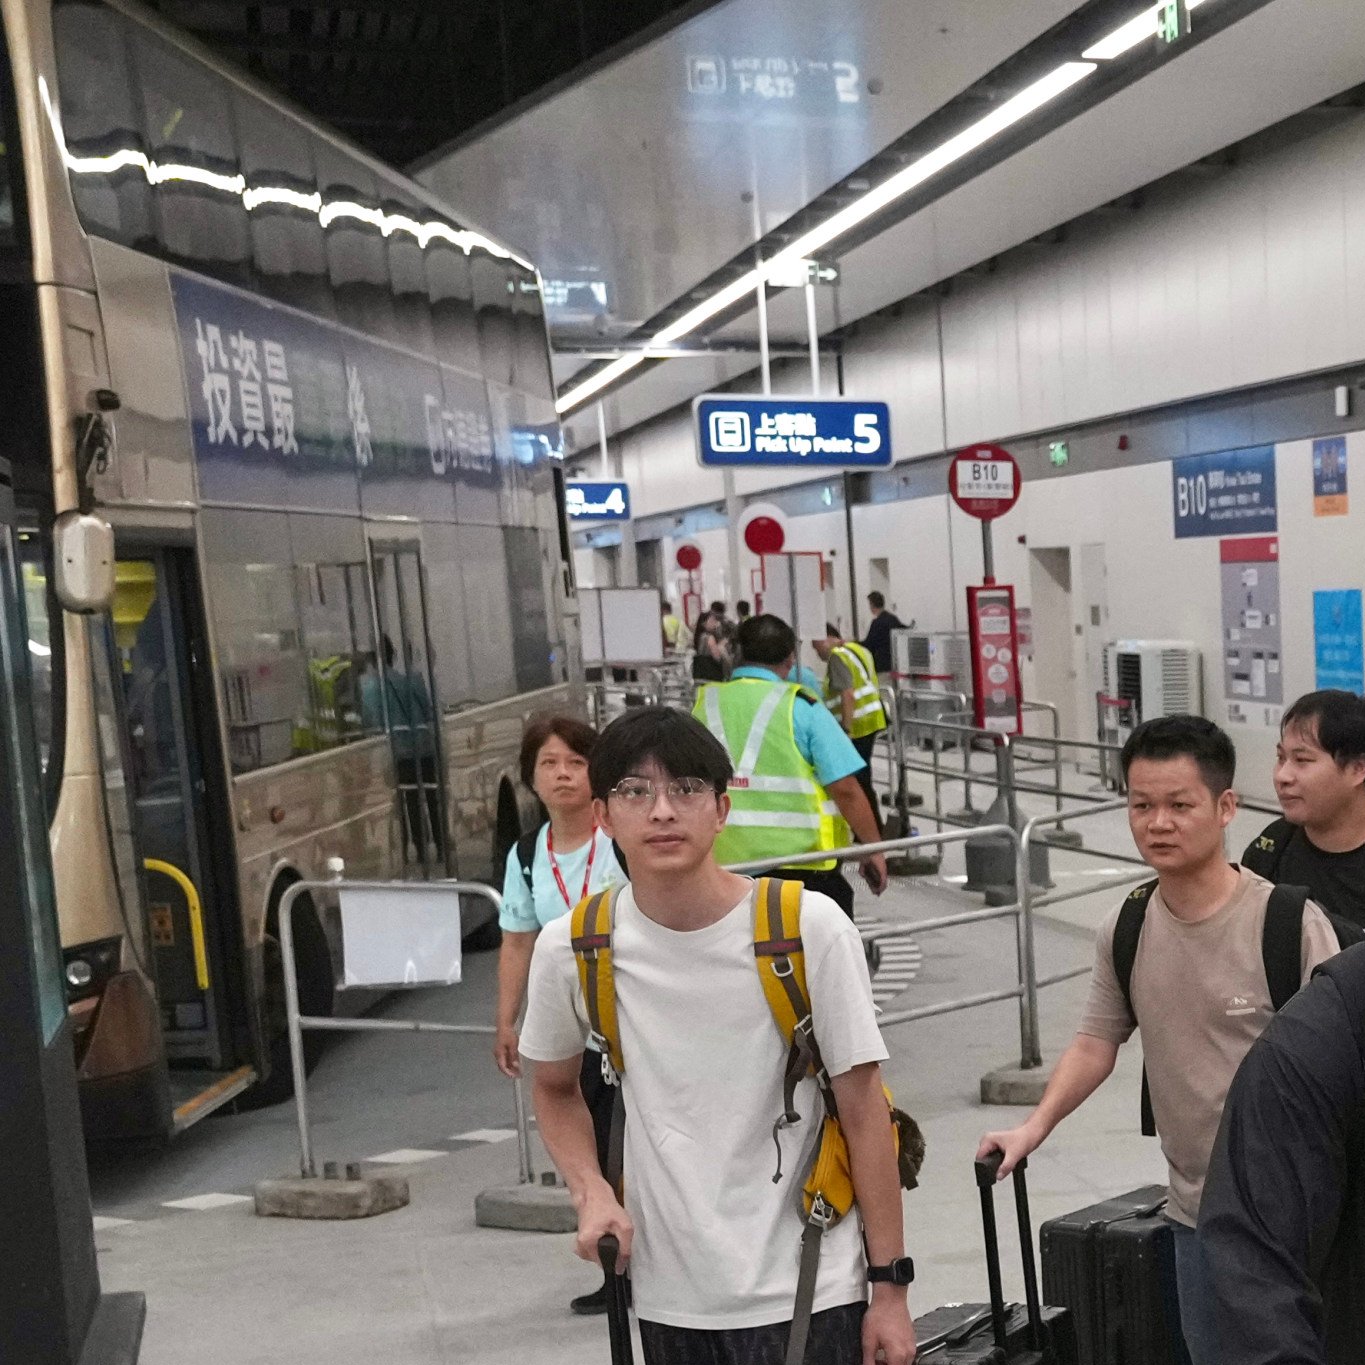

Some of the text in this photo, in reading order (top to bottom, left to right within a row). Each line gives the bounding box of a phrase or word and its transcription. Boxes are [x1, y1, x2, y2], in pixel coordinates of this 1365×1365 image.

[756, 436, 853, 457] Pick Up Point
[854, 413, 881, 454] 5
[972, 464, 998, 481] B10
[605, 488, 625, 514] 4
[1178, 473, 1207, 518] B10
